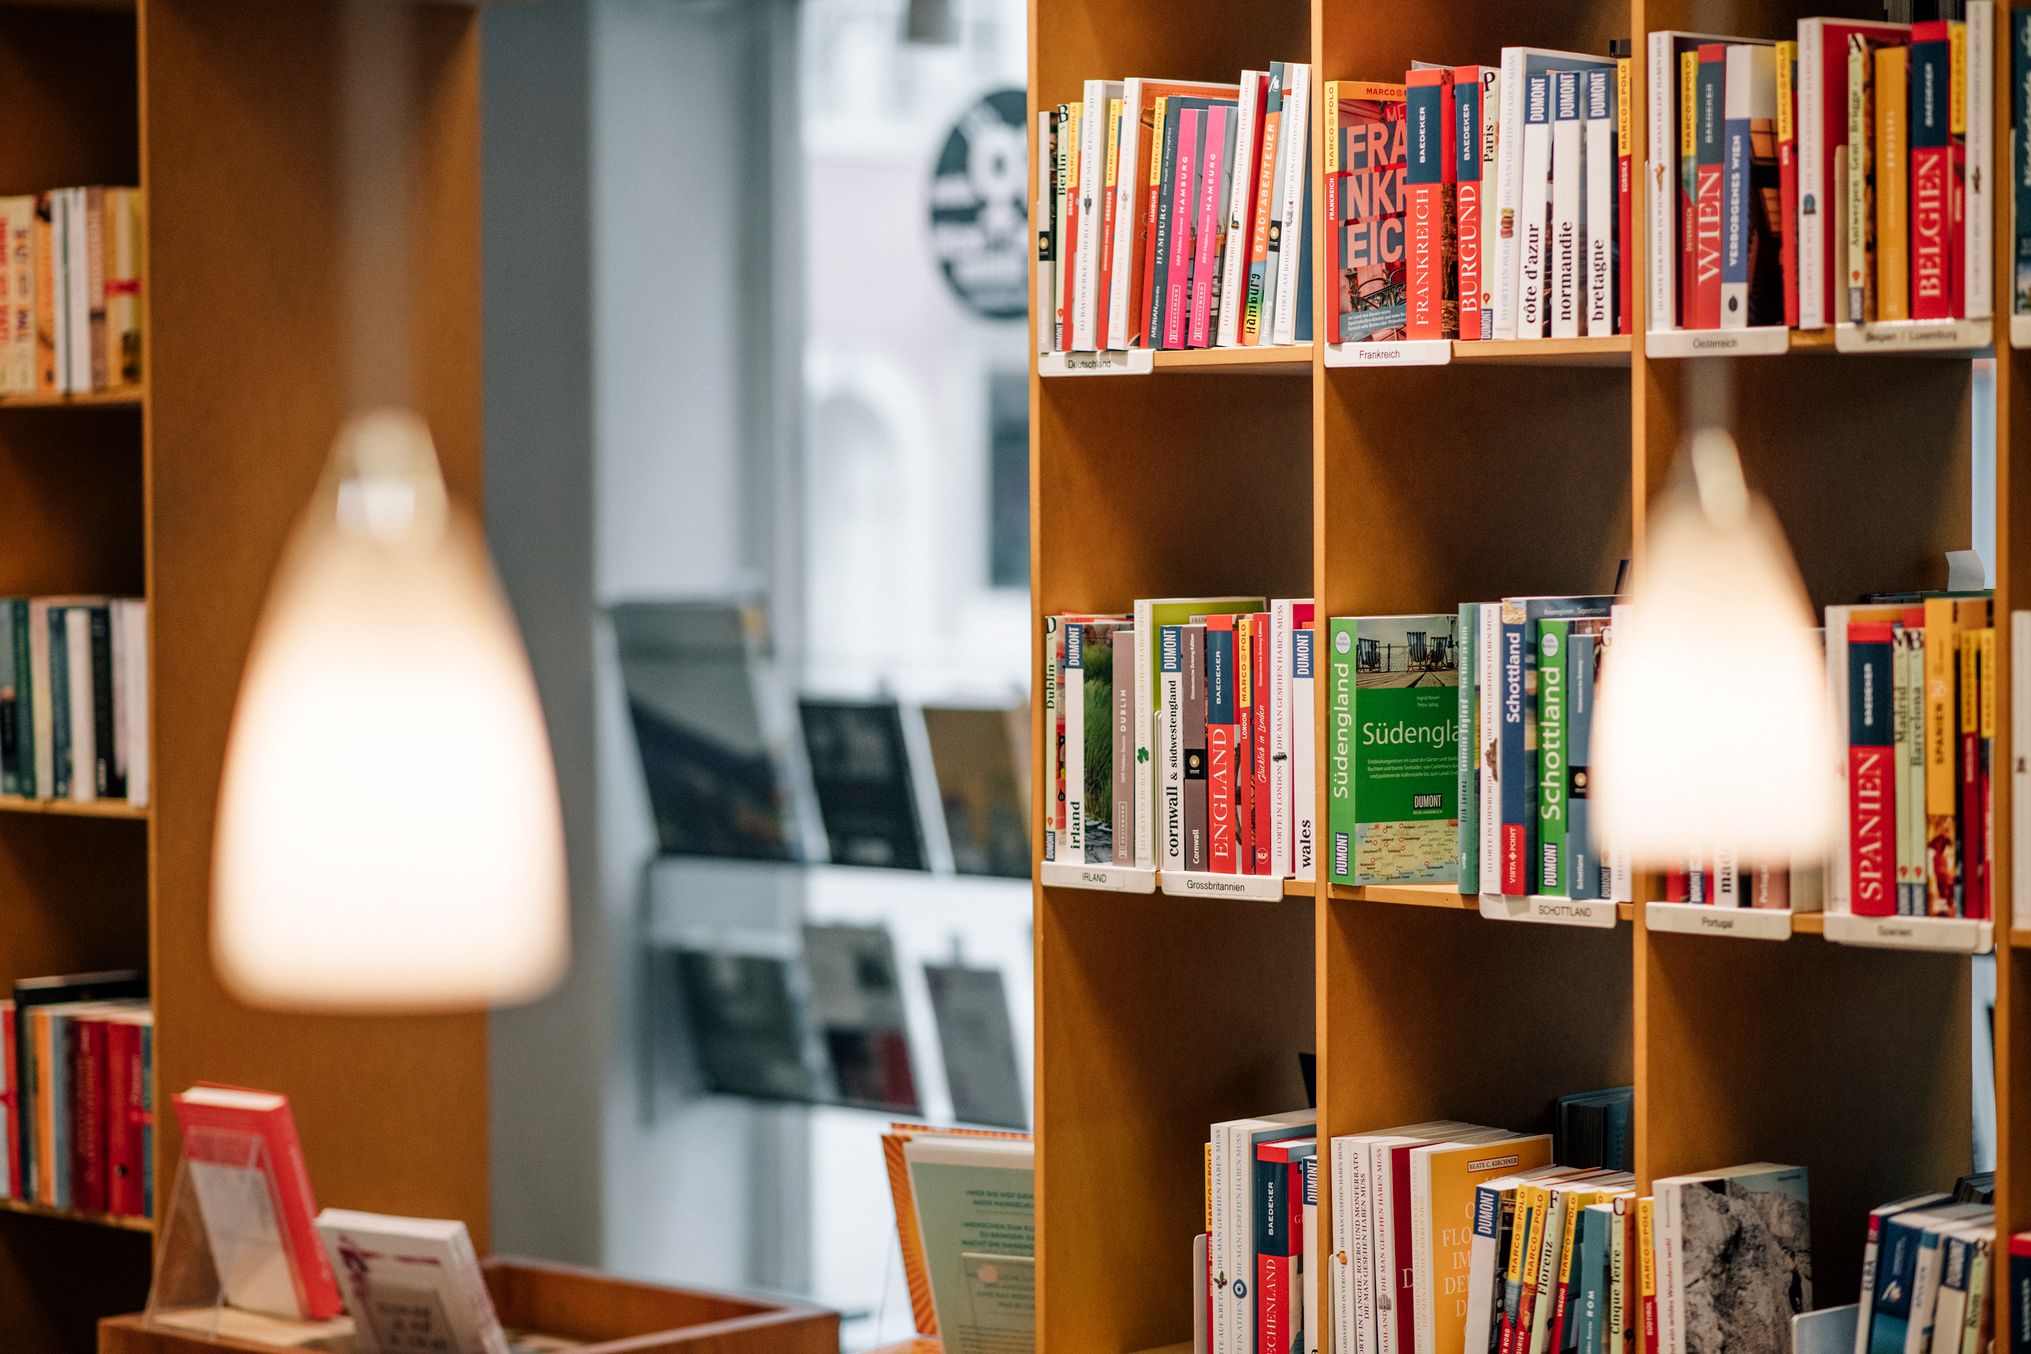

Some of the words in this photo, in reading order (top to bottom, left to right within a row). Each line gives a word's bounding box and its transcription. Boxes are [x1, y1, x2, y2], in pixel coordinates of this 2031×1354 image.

[1530, 77, 1545, 121] DUMONT
[1559, 74, 1575, 117] DUMONT
[1590, 73, 1605, 116] DUMONT
[1484, 124, 1494, 162] Paris
[1731, 135, 1741, 169] WIEN
[1058, 154, 1066, 195] Berlin
[1179, 156, 1188, 213] HAMBURG
[1206, 154, 1216, 211] HAMBURG
[1156, 204, 1167, 264] HAMBURG
[1246, 274, 1260, 334] Hamburg
[1255, 124, 1275, 253] STADTABENTEUER
[1698, 171, 1720, 286] WIEN
[1730, 173, 1741, 266] VERBORGENES
[1919, 154, 1941, 296] BELGIEN
[1416, 189, 1428, 325] FRANKREICH
[1460, 185, 1477, 312] BURGUND
[1558, 222, 1572, 320] normandie
[1592, 240, 1606, 320] bretagne
[1524, 286, 1536, 323] côte
[1360, 350, 1400, 359] Frankreich
[1693, 338, 1737, 349] Oesterreich
[1069, 627, 1080, 666] DUMONT
[1164, 630, 1177, 669] DUMONT
[1297, 634, 1309, 675] DUMONT
[1046, 665, 1054, 709] Dublin
[1506, 632, 1520, 723] Schottland
[1168, 680, 1178, 768] südwestengland
[1256, 705, 1266, 732] London
[1334, 663, 1351, 798] Südengland
[1460, 700, 1471, 733] England
[1257, 747, 1267, 783] Glücklich
[1540, 667, 1560, 820] Schottland
[1170, 772, 1178, 780] &
[1213, 728, 1229, 858] ENGLAND
[1166, 786, 1179, 857] cornwall
[1277, 807, 1282, 817] IN
[1414, 795, 1441, 808] DUMONT
[1046, 833, 1054, 859] DUMONT
[1070, 802, 1080, 849] irland
[1300, 820, 1311, 867] wales
[1858, 752, 1883, 900] SPANIEN
[1336, 833, 1348, 875] DUMONT
[1543, 844, 1557, 886] DUMONT
[1082, 873, 1107, 883] IRLAND
[1187, 880, 1245, 892] Grossbritannien
[1539, 905, 1592, 917] SCHOTTLAND
[1702, 917, 1734, 929] Portugal
[1469, 1162, 1485, 1170] BEATE
[1491, 1157, 1518, 1167] KIRCHNER
[1478, 1191, 1494, 1234] DUMONT
[1511, 1233, 1520, 1274] MARCO
[1516, 1191, 1525, 1221] POLO
[1527, 1236, 1538, 1277] MARCO
[1533, 1194, 1543, 1224] POLO
[1561, 1238, 1571, 1277] MARCO
[1567, 1197, 1576, 1225] POLO
[1538, 1240, 1553, 1296] Florenz
[1611, 1250, 1621, 1284] Terre
[1357, 1319, 1363, 1329] IN
[1557, 1288, 1565, 1317] VENEDIG
[1587, 1290, 1595, 1317] ROM
[1611, 1289, 1623, 1334] Cinque
[1237, 1334, 1242, 1343] IN
